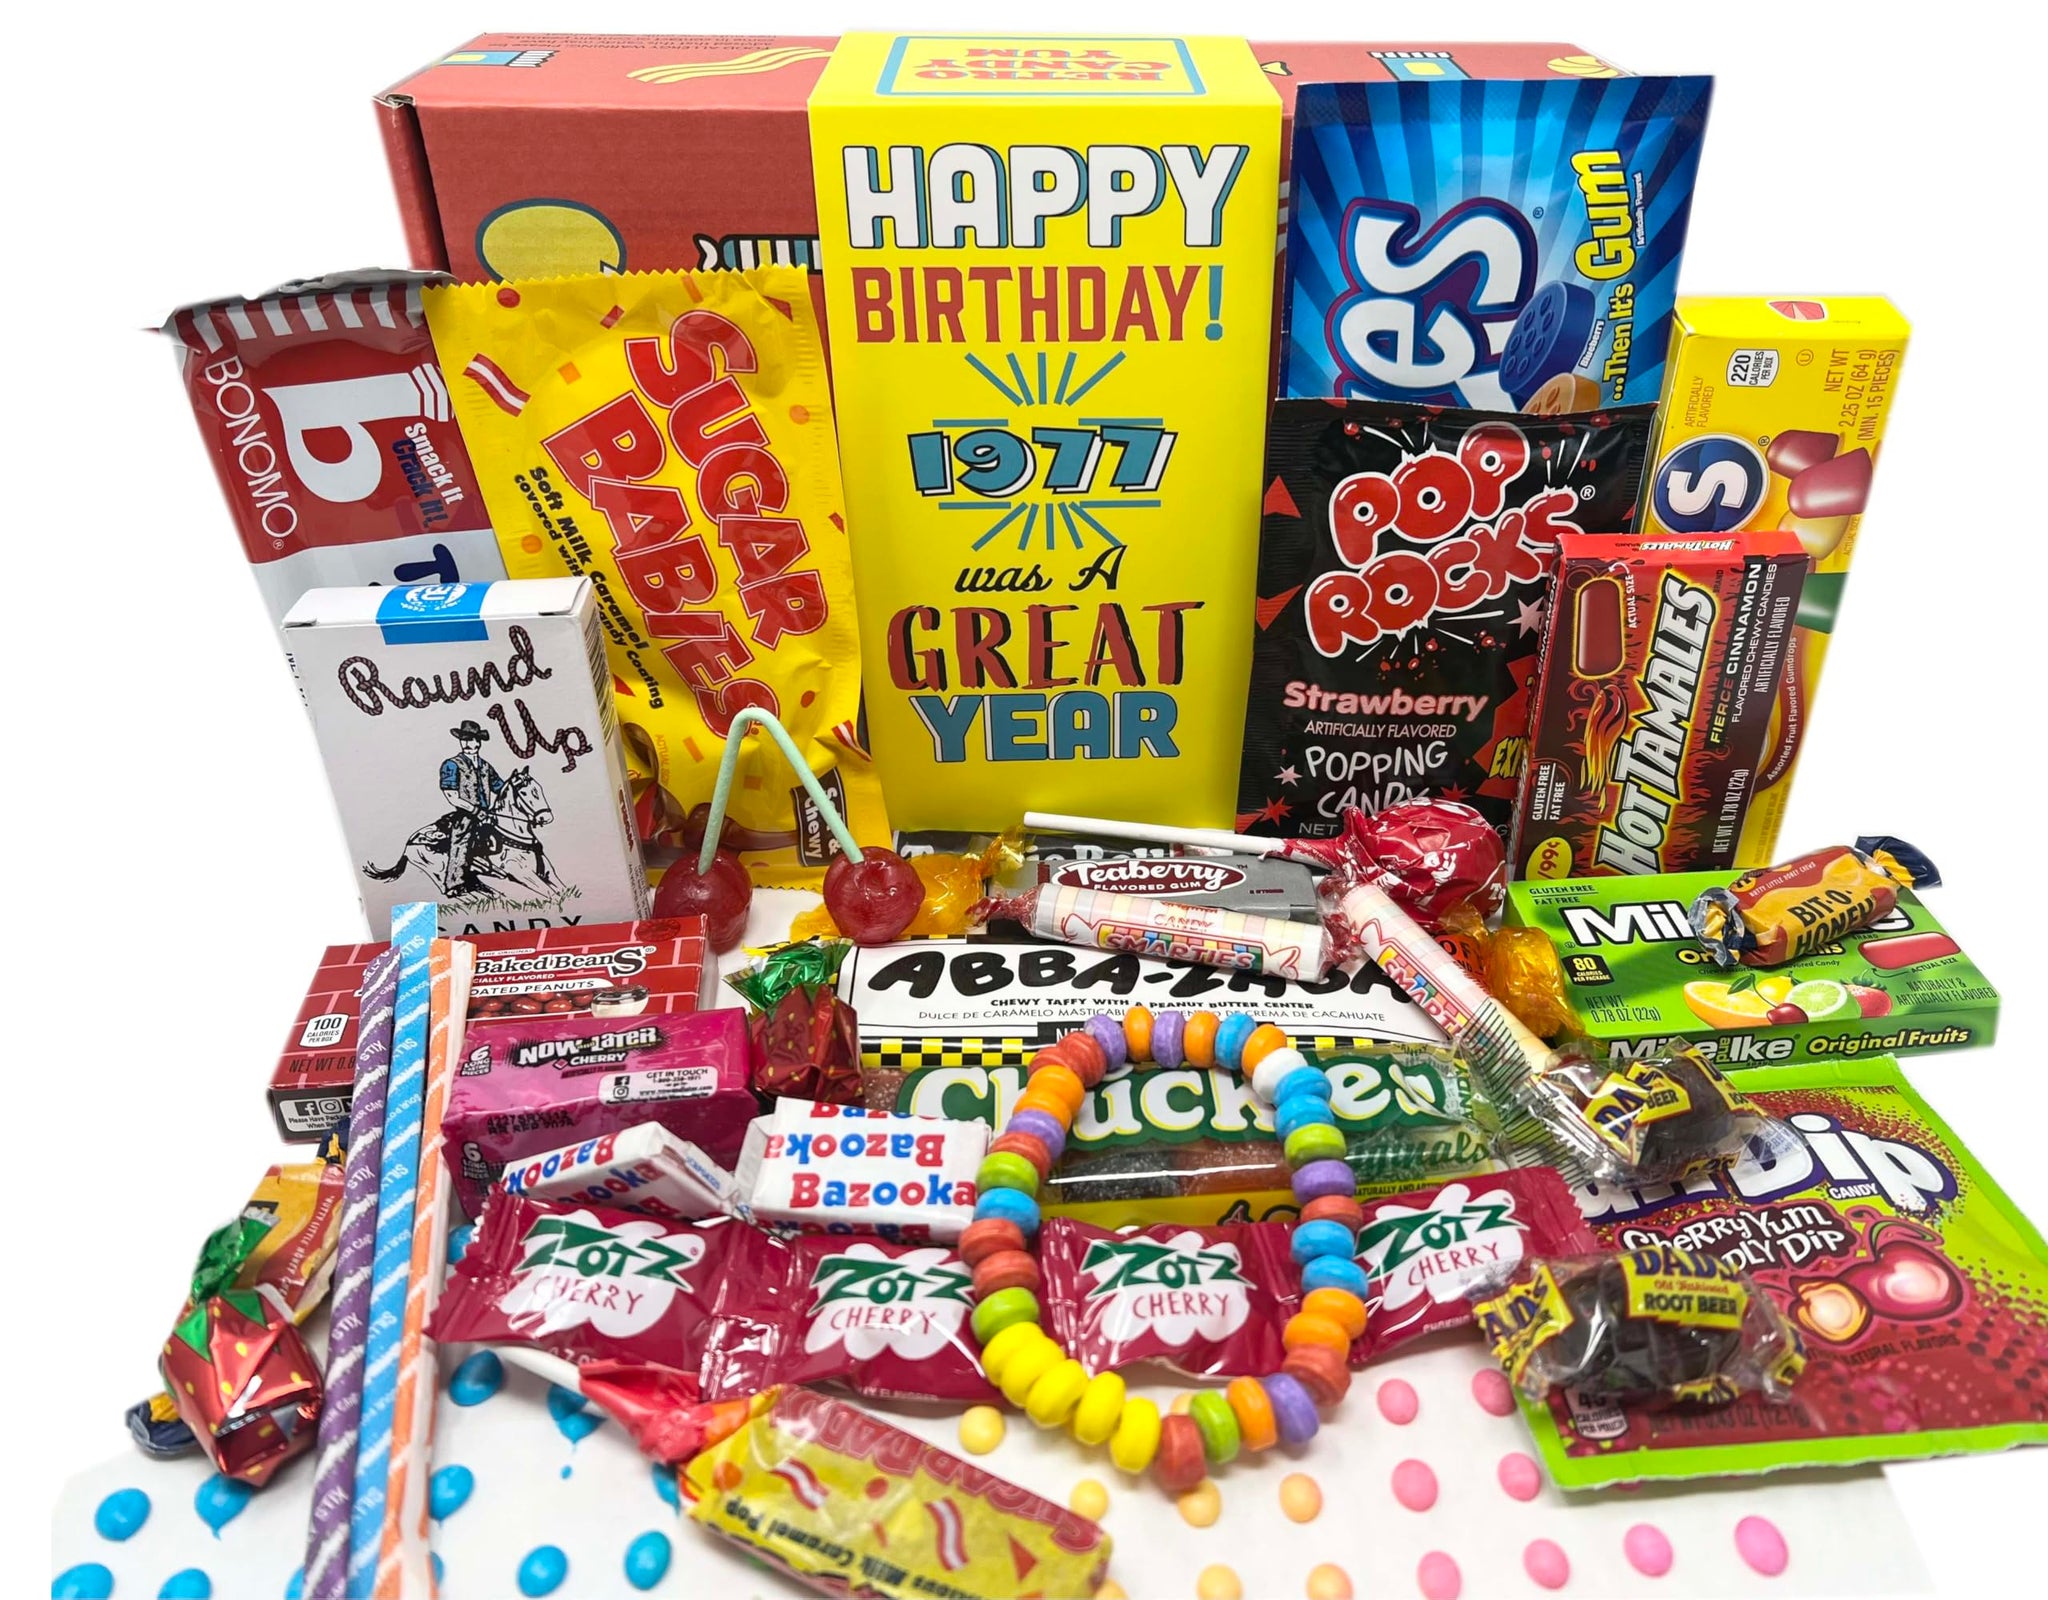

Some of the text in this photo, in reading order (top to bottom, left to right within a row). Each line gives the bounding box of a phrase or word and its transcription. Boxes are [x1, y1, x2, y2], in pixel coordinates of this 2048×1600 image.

[915, 70, 1164, 82] RETRO
[927, 60, 1171, 70] CANDY
[842, 143, 1249, 249] HAPPY
[1570, 150, 1635, 280] Gum
[851, 265, 1223, 343] BIRTHDAY!
[1609, 282, 1635, 318] It's
[1580, 320, 1604, 368] Blueberry
[1731, 354, 1751, 382] 220
[1749, 350, 1765, 385] CALORIES
[1761, 355, 1773, 381] PER BOX
[1824, 348, 1850, 393] NET WT
[1684, 376, 1706, 428] ARTIFICIALLY
[1697, 386, 1714, 428] FLAVORED
[1838, 361, 1870, 428] 2.25 OZ (64
[1857, 349, 1900, 441] (MIN. 15 PIECES)
[204, 355, 298, 538] BONOMO
[405, 422, 446, 488] Smack
[907, 426, 1178, 498] 1977
[391, 437, 429, 498] Crack
[624, 309, 829, 651] SUGAR
[1329, 422, 1530, 568] POP
[529, 466, 650, 649] Soft Milk Caramel
[541, 390, 780, 741] BABIES
[954, 545, 1127, 593] was A
[1305, 485, 1584, 658] ROCKS
[514, 474, 562, 541] covered
[626, 649, 665, 710] Coating
[1625, 574, 1639, 629] ACTUAL SIZE
[887, 601, 1205, 692] GREAT
[1710, 564, 1762, 744] FIERCE CINNAMON
[1732, 563, 1777, 723] FLAVORED CHEWY CANDIES
[1754, 596, 1791, 693] ARTIFICIALLY FLAVORED
[338, 625, 552, 717] Round
[1612, 573, 1717, 800] TAMALES
[1283, 680, 1488, 722] Strawberry
[1767, 636, 1798, 781] Assorted Fruit Flavored Gumdrops
[487, 698, 594, 773] Up
[909, 691, 1180, 763] YEAR
[1304, 719, 1457, 739] ARTIFICIALLY FLAVORED
[1305, 740, 1448, 783] POPPING
[1538, 764, 1550, 786] FREE
[1532, 787, 1546, 821] GLUTEN
[1550, 781, 1565, 821] FAT FREE
[1298, 822, 1339, 836] NET
[1068, 860, 1229, 889] Teaberry
[1094, 881, 1201, 891] FLAVORED GUM
[1529, 886, 1568, 895] GLUTEN
[1749, 861, 1817, 898] NUTTY LITTLE HONEY CHEWS
[1796, 897, 1874, 954] HONEY
[475, 955, 548, 975] Baked
[1105, 934, 1256, 969] SMARTIES
[1572, 957, 1597, 971] 80
[1815, 959, 1840, 968] Candy
[1911, 957, 1958, 974] ACTUAL SIZE
[507, 973, 555, 983] FLAVORED
[524, 980, 595, 993] PEANUTS
[1906, 977, 1966, 992] NATURALLY &
[990, 999, 1041, 1007] CHEWY
[1047, 998, 1089, 1006] TAFFY
[1585, 995, 1629, 1009] NET WT.
[1896, 987, 1999, 1006] ARTIFICIALLY FLAVORED
[314, 1017, 342, 1031] 100
[919, 1011, 959, 1020] DULCE
[963, 1011, 979, 1019] DE
[983, 1008, 1053, 1019] CARAMELO
[1246, 1010, 1291, 1018] CREMA
[1314, 1011, 1385, 1022] CACAHUATE
[1591, 1007, 1661, 1023] 0.78 OZ (22g)
[306, 1030, 340, 1038] CALORIES
[360, 1040, 387, 1062] STIX
[518, 1037, 580, 1066] NOW
[1729, 1036, 1795, 1062] Ike
[1809, 1027, 1969, 1056] Original Fruits
[289, 1057, 335, 1073] NET WT
[463, 1058, 490, 1068] LONG
[470, 1046, 491, 1061] 6
[570, 1052, 627, 1066] CHERRY
[461, 1069, 490, 1077] PIECES
[646, 1071, 664, 1079] GET
[677, 1068, 709, 1077] TOUCH
[910, 1066, 1434, 1142] Chuckes
[463, 1142, 482, 1162] 6
[764, 1133, 946, 1167] Bazooka
[347, 1164, 376, 1190] STIX
[789, 1172, 977, 1209] Bazooka
[1829, 1184, 1878, 1200] CANDY
[514, 1216, 697, 1293] ZOTZ
[1354, 1204, 1527, 1281] ZOTZ
[1080, 1241, 1257, 1290] ZOTZ
[1408, 1242, 1500, 1286] CHERRY
[533, 1275, 645, 1316] CHERRY
[809, 1255, 978, 1318] ZOTZ
[830, 1306, 938, 1333] CHERRY
[1132, 1291, 1232, 1321] CHERRY
[1644, 1294, 1737, 1315] ROOT BEER
[332, 1312, 363, 1341] STIX
[1840, 1342, 1897, 1365] NATURAL
[314, 1486, 349, 1522] STIX
[725, 1496, 763, 1531] Pop
[764, 1518, 855, 1568] Caramel
[860, 1553, 903, 1593] Milk
